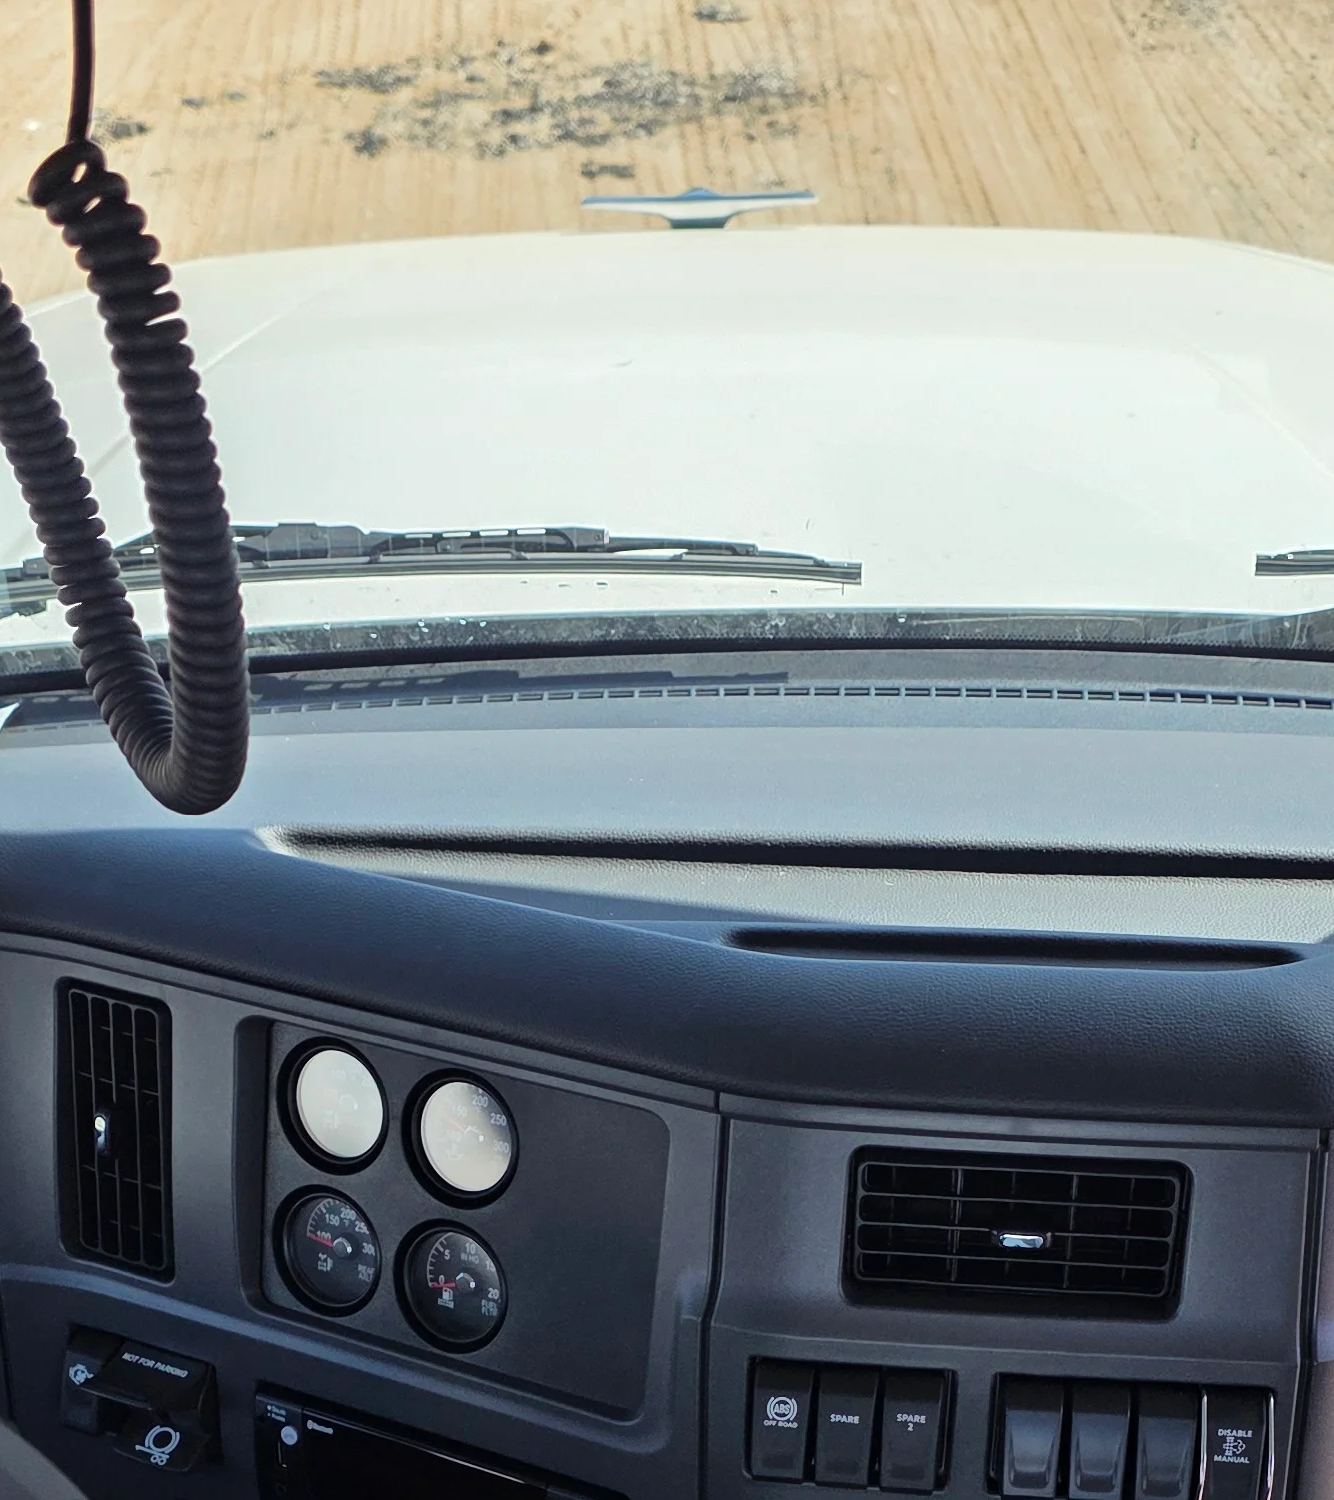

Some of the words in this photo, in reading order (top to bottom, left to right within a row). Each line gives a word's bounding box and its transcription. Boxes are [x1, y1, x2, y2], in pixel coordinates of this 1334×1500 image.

[472, 1095, 488, 1108] 200
[490, 1112, 507, 1127] 250
[325, 1213, 340, 1226] 150
[340, 1207, 357, 1221] 200
[465, 1242, 477, 1255] 10
[444, 1249, 451, 1261] 5
[438, 1274, 446, 1285] 0
[488, 1287, 500, 1300] 20
[137, 1357, 155, 1368] FOR
[773, 1403, 790, 1415] ABS
[830, 1413, 860, 1424] SPARE
[896, 1413, 926, 1423] SPARE
[763, 1419, 776, 1427] OFF
[778, 1421, 799, 1429] ROAD
[907, 1423, 914, 1431] 2
[1217, 1428, 1253, 1438] DISABLE
[1213, 1454, 1250, 1464] MANUAL
